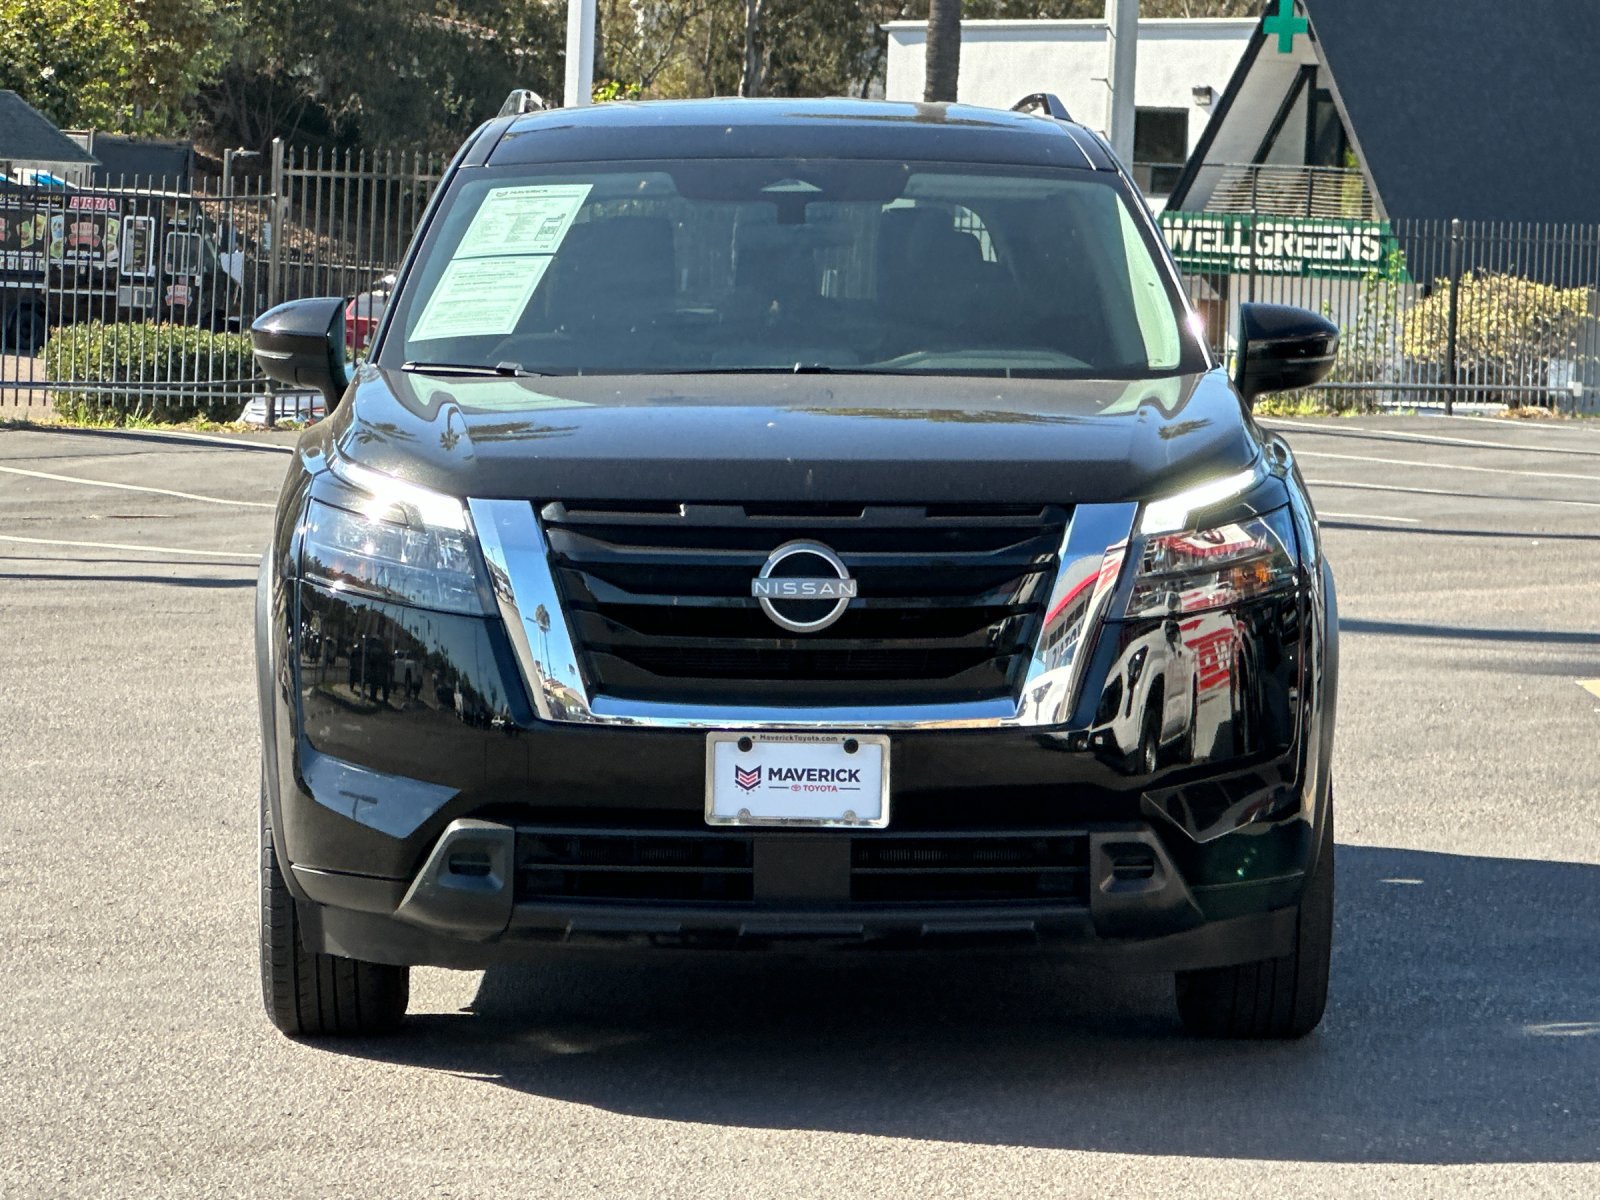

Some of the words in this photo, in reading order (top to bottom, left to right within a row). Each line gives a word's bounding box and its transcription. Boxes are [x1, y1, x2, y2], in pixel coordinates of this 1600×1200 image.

[69, 196, 116, 211] BIRRIA
[1163, 217, 1381, 262] WELLGREENS
[755, 582, 854, 595] NISSAN
[760, 734, 838, 742] MaverickToyota.com
[768, 768, 861, 783] MAVERICK
[803, 785, 838, 793] TOYOTA
